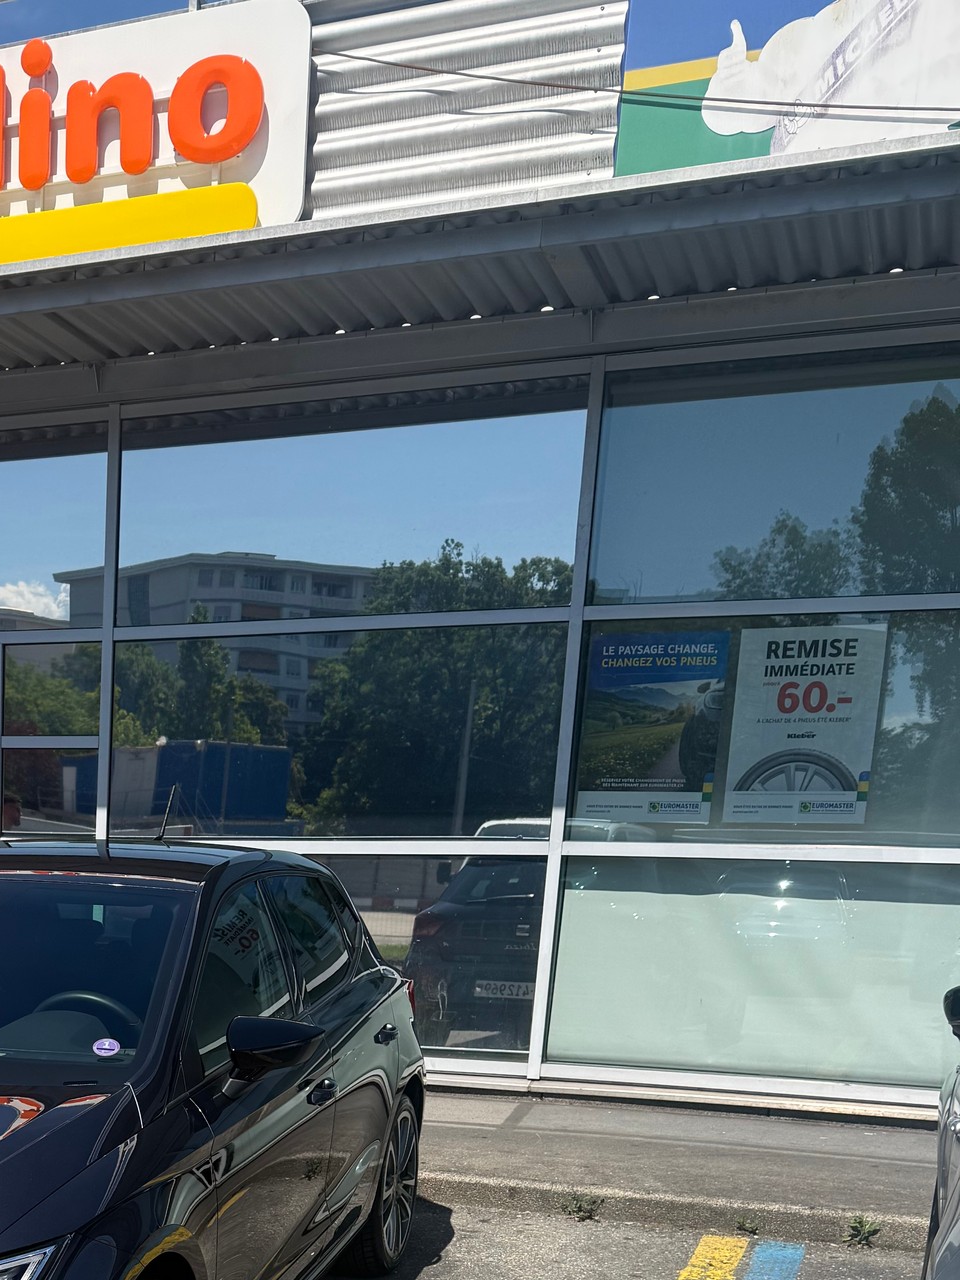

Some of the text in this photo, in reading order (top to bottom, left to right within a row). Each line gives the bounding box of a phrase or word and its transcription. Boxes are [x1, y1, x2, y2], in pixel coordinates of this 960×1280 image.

[603, 643, 718, 656] LE PAYSAGE CHANGE,
[766, 638, 859, 660] REMISE
[601, 656, 718, 668] CHANGEZ VOS PNEUS
[764, 661, 856, 677] IMMÉDIATE
[777, 681, 853, 714] 60.-
[103, 1041, 110, 1049] 1
